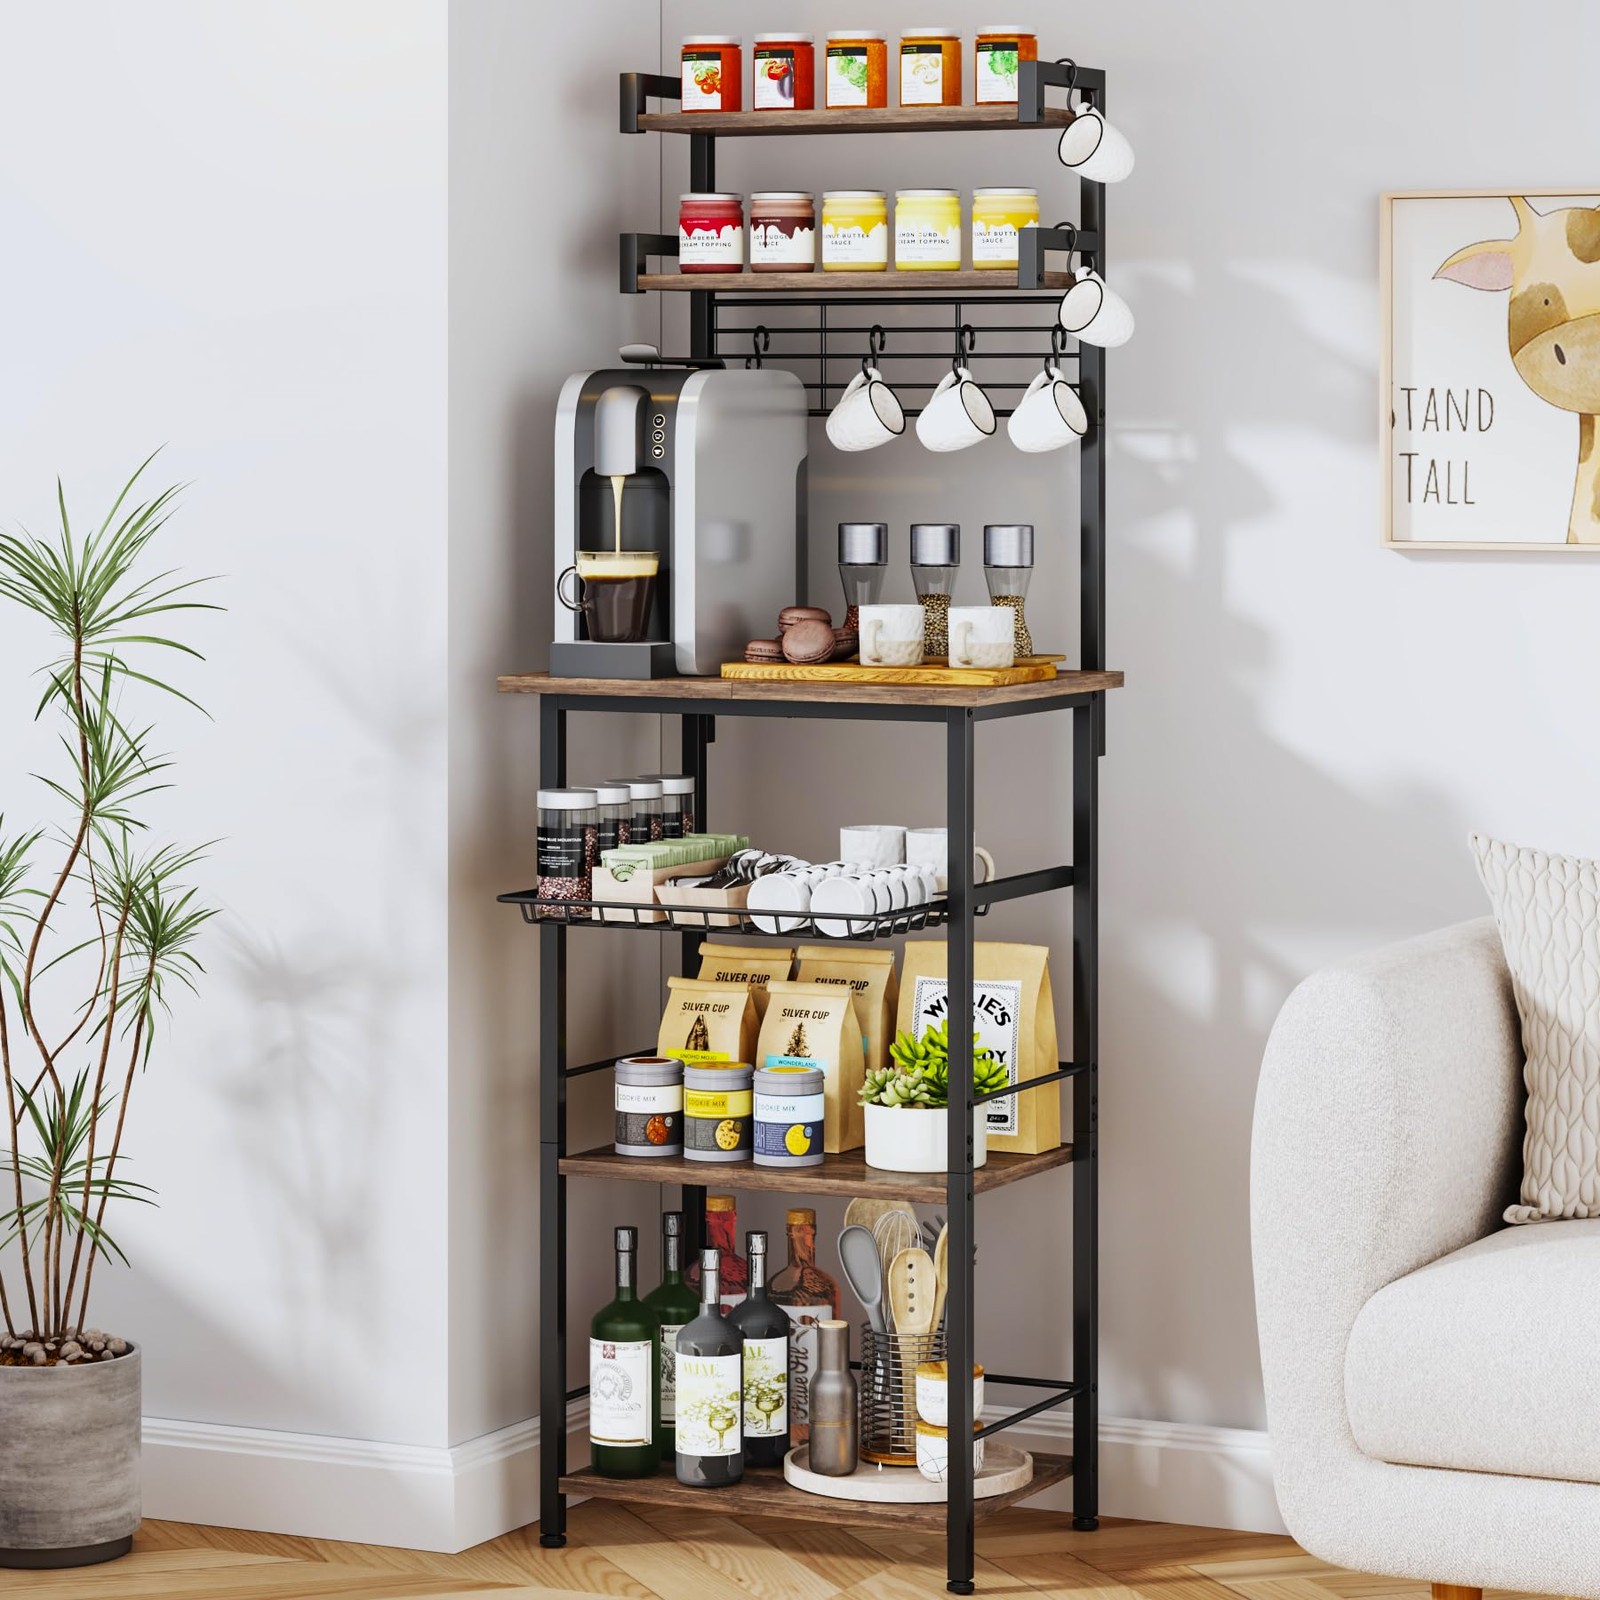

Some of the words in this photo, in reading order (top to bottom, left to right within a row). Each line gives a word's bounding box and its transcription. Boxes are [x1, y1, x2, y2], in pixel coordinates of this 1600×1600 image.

[1392, 386, 1494, 432] TAND
[1399, 453, 1475, 504] TALL
[715, 971, 749, 983] SILVER
[750, 973, 771, 984] CUP
[849, 979, 870, 991] CUP
[681, 1001, 711, 1012] SILVER
[712, 1003, 730, 1013] CUP
[922, 994, 1011, 1027] WIIE'S
[781, 1008, 811, 1019] SILVER
[811, 1010, 830, 1020] CUP
[778, 1059, 817, 1068] WONDERLAND
